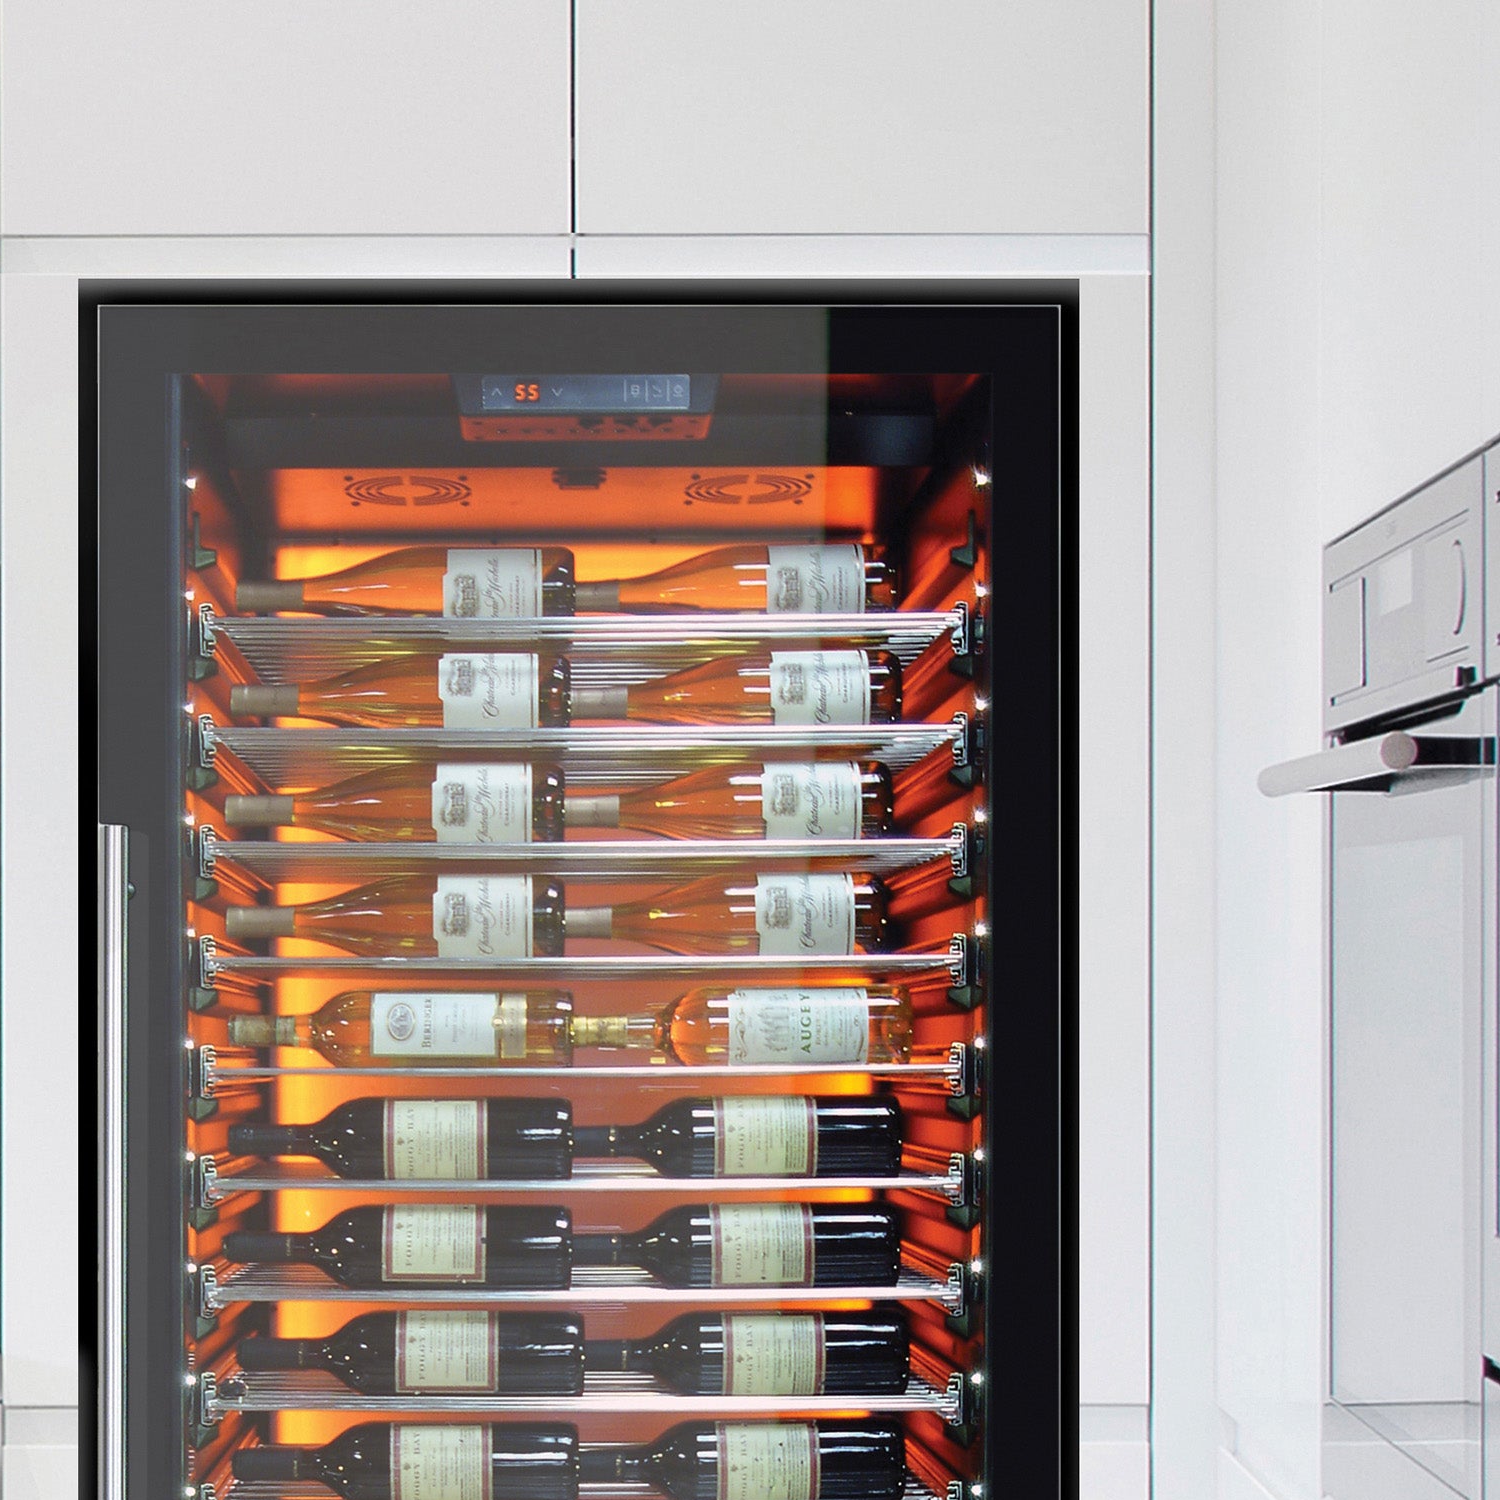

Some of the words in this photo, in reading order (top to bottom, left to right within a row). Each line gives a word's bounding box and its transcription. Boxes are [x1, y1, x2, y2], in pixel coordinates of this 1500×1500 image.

[514, 384, 540, 401] 55
[421, 998, 432, 1048] BERINGER
[798, 993, 812, 1054] AUGEY
